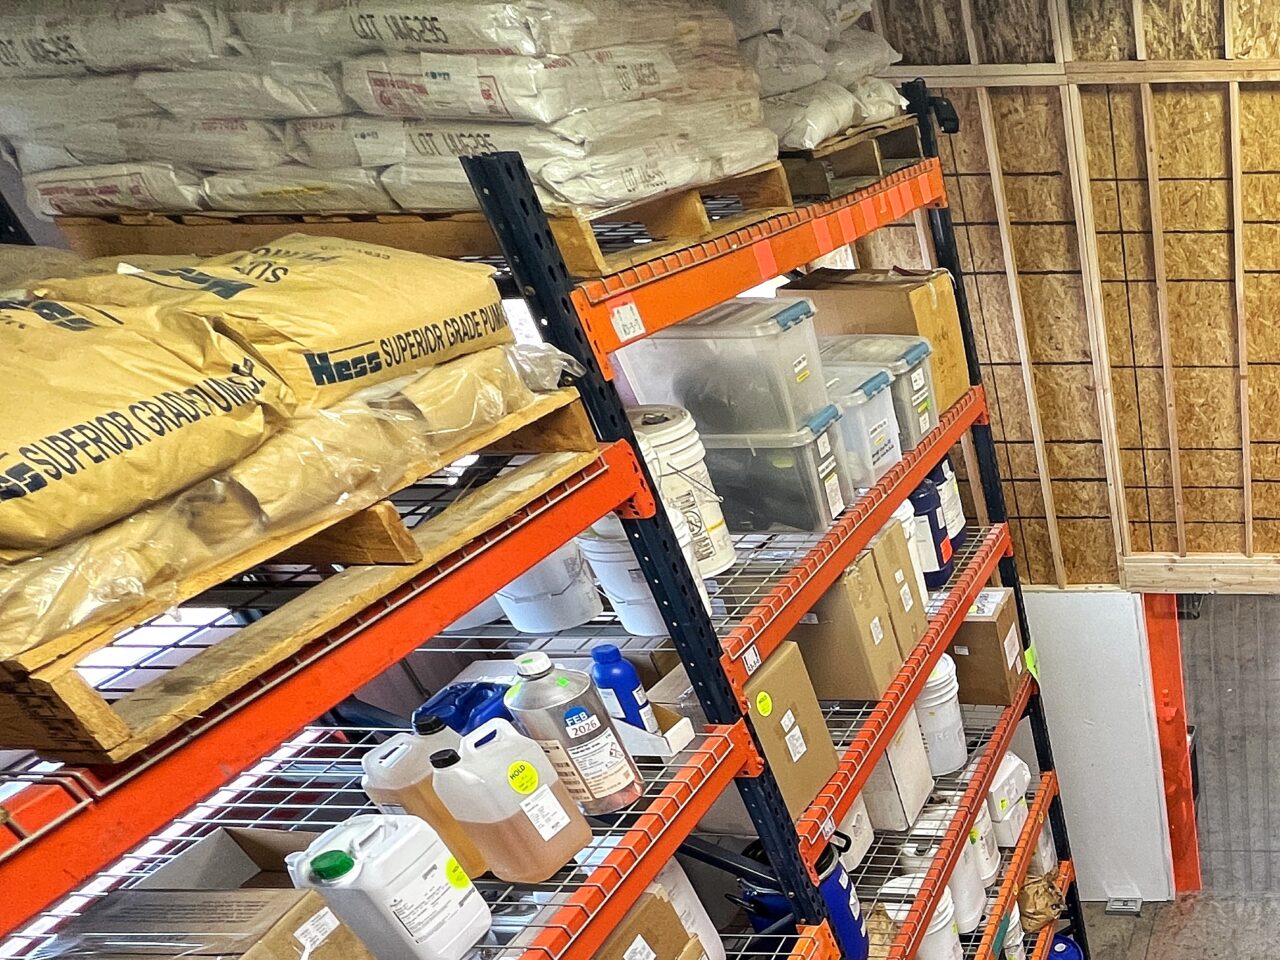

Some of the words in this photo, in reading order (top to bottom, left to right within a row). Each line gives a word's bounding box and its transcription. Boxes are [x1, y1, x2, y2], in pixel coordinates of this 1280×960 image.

[304, 351, 383, 387] Hess
[380, 323, 444, 369] SUPERIOR
[443, 311, 484, 348] GRADE
[19, 411, 152, 481] SUPERIOR
[566, 711, 589, 727] FEB
[571, 720, 598, 737] 2026
[510, 764, 526, 781] HOLD
